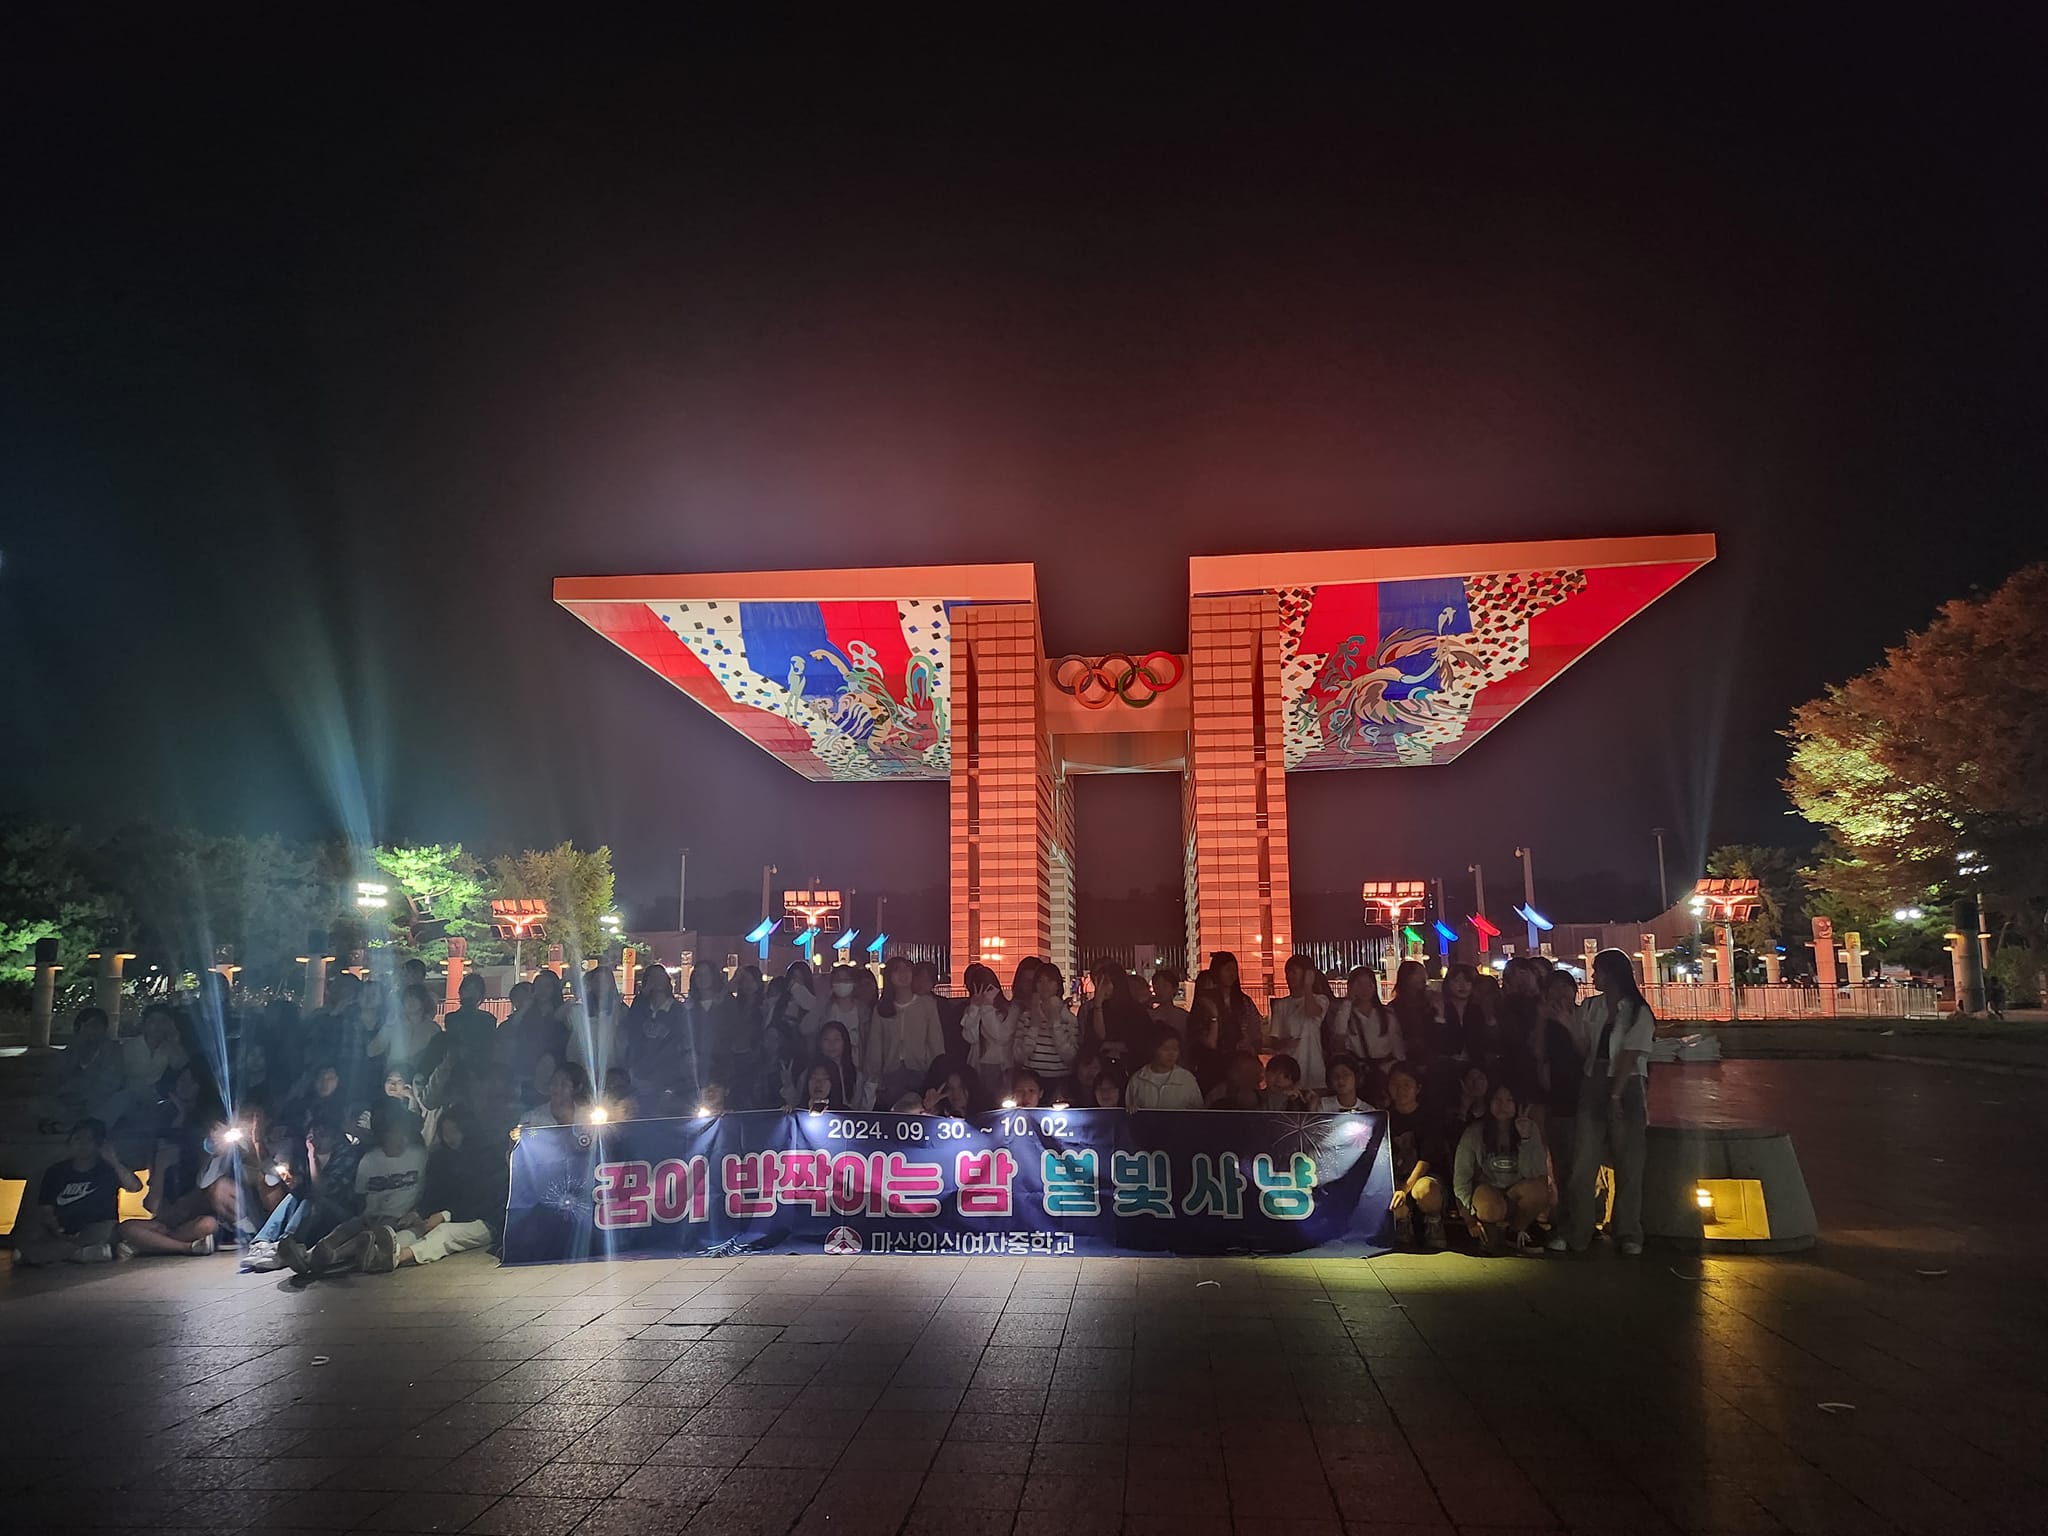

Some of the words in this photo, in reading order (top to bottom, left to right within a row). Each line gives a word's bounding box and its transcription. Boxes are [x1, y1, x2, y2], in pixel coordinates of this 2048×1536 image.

[827, 1119, 888, 1139] 2024.
[896, 1122, 930, 1140] 09.
[937, 1122, 971, 1140] 30.
[1001, 1116, 1033, 1137] 10.
[1040, 1116, 1074, 1137] 02.
[592, 1155, 710, 1230] 꿈이
[721, 1149, 943, 1219] 반짝이는
[954, 1147, 1019, 1217] 밤
[870, 1230, 1075, 1255] 마산의신여자중학교
